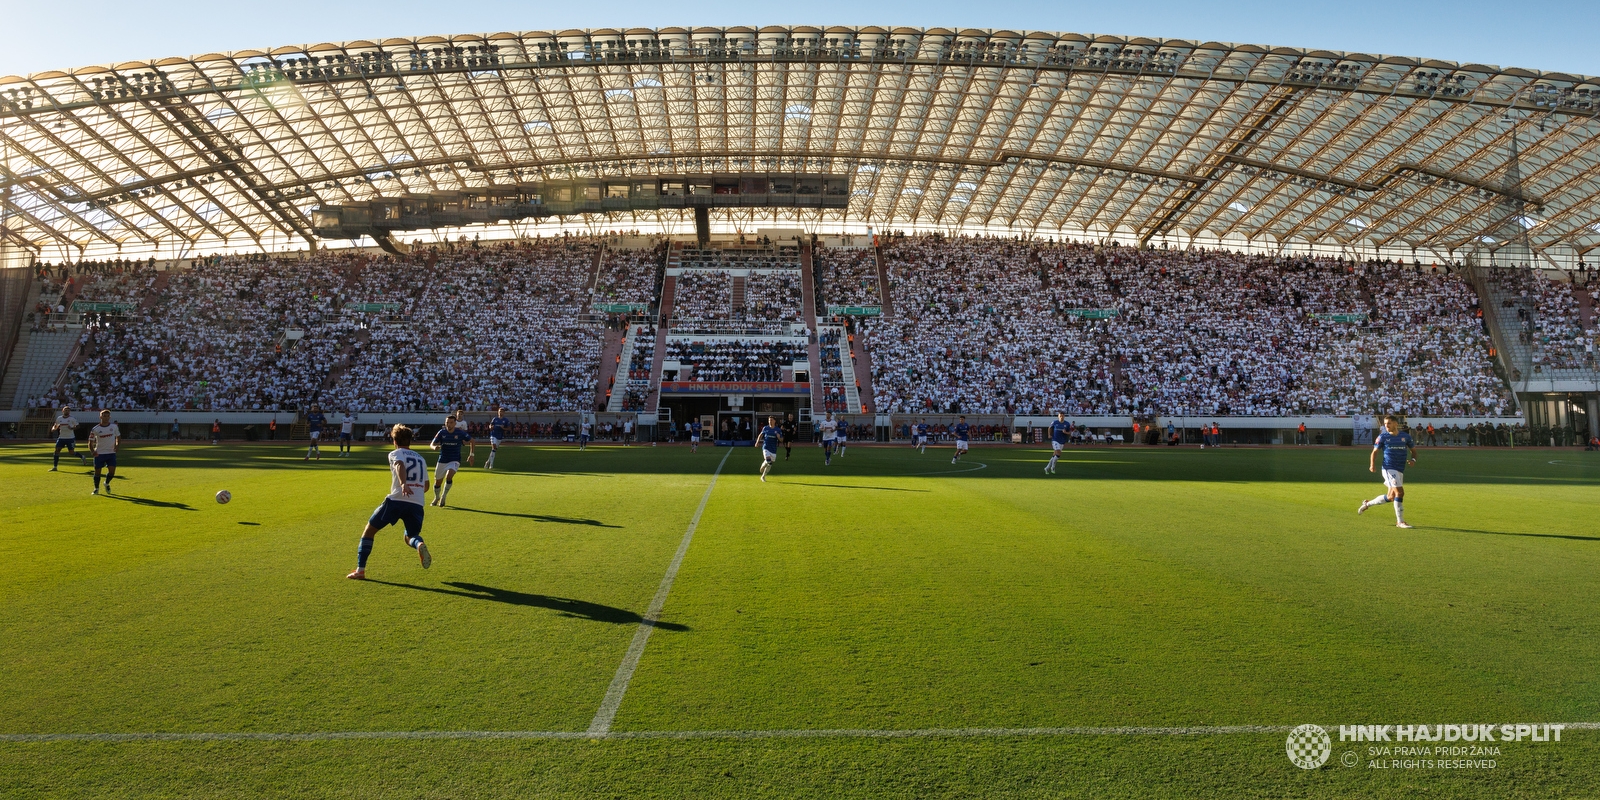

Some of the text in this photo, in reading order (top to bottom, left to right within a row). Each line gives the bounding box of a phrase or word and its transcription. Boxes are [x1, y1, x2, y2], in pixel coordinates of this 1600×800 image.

[689, 383, 783, 391] HNK HAJDUK SPLIT
[406, 456, 424, 482] 21
